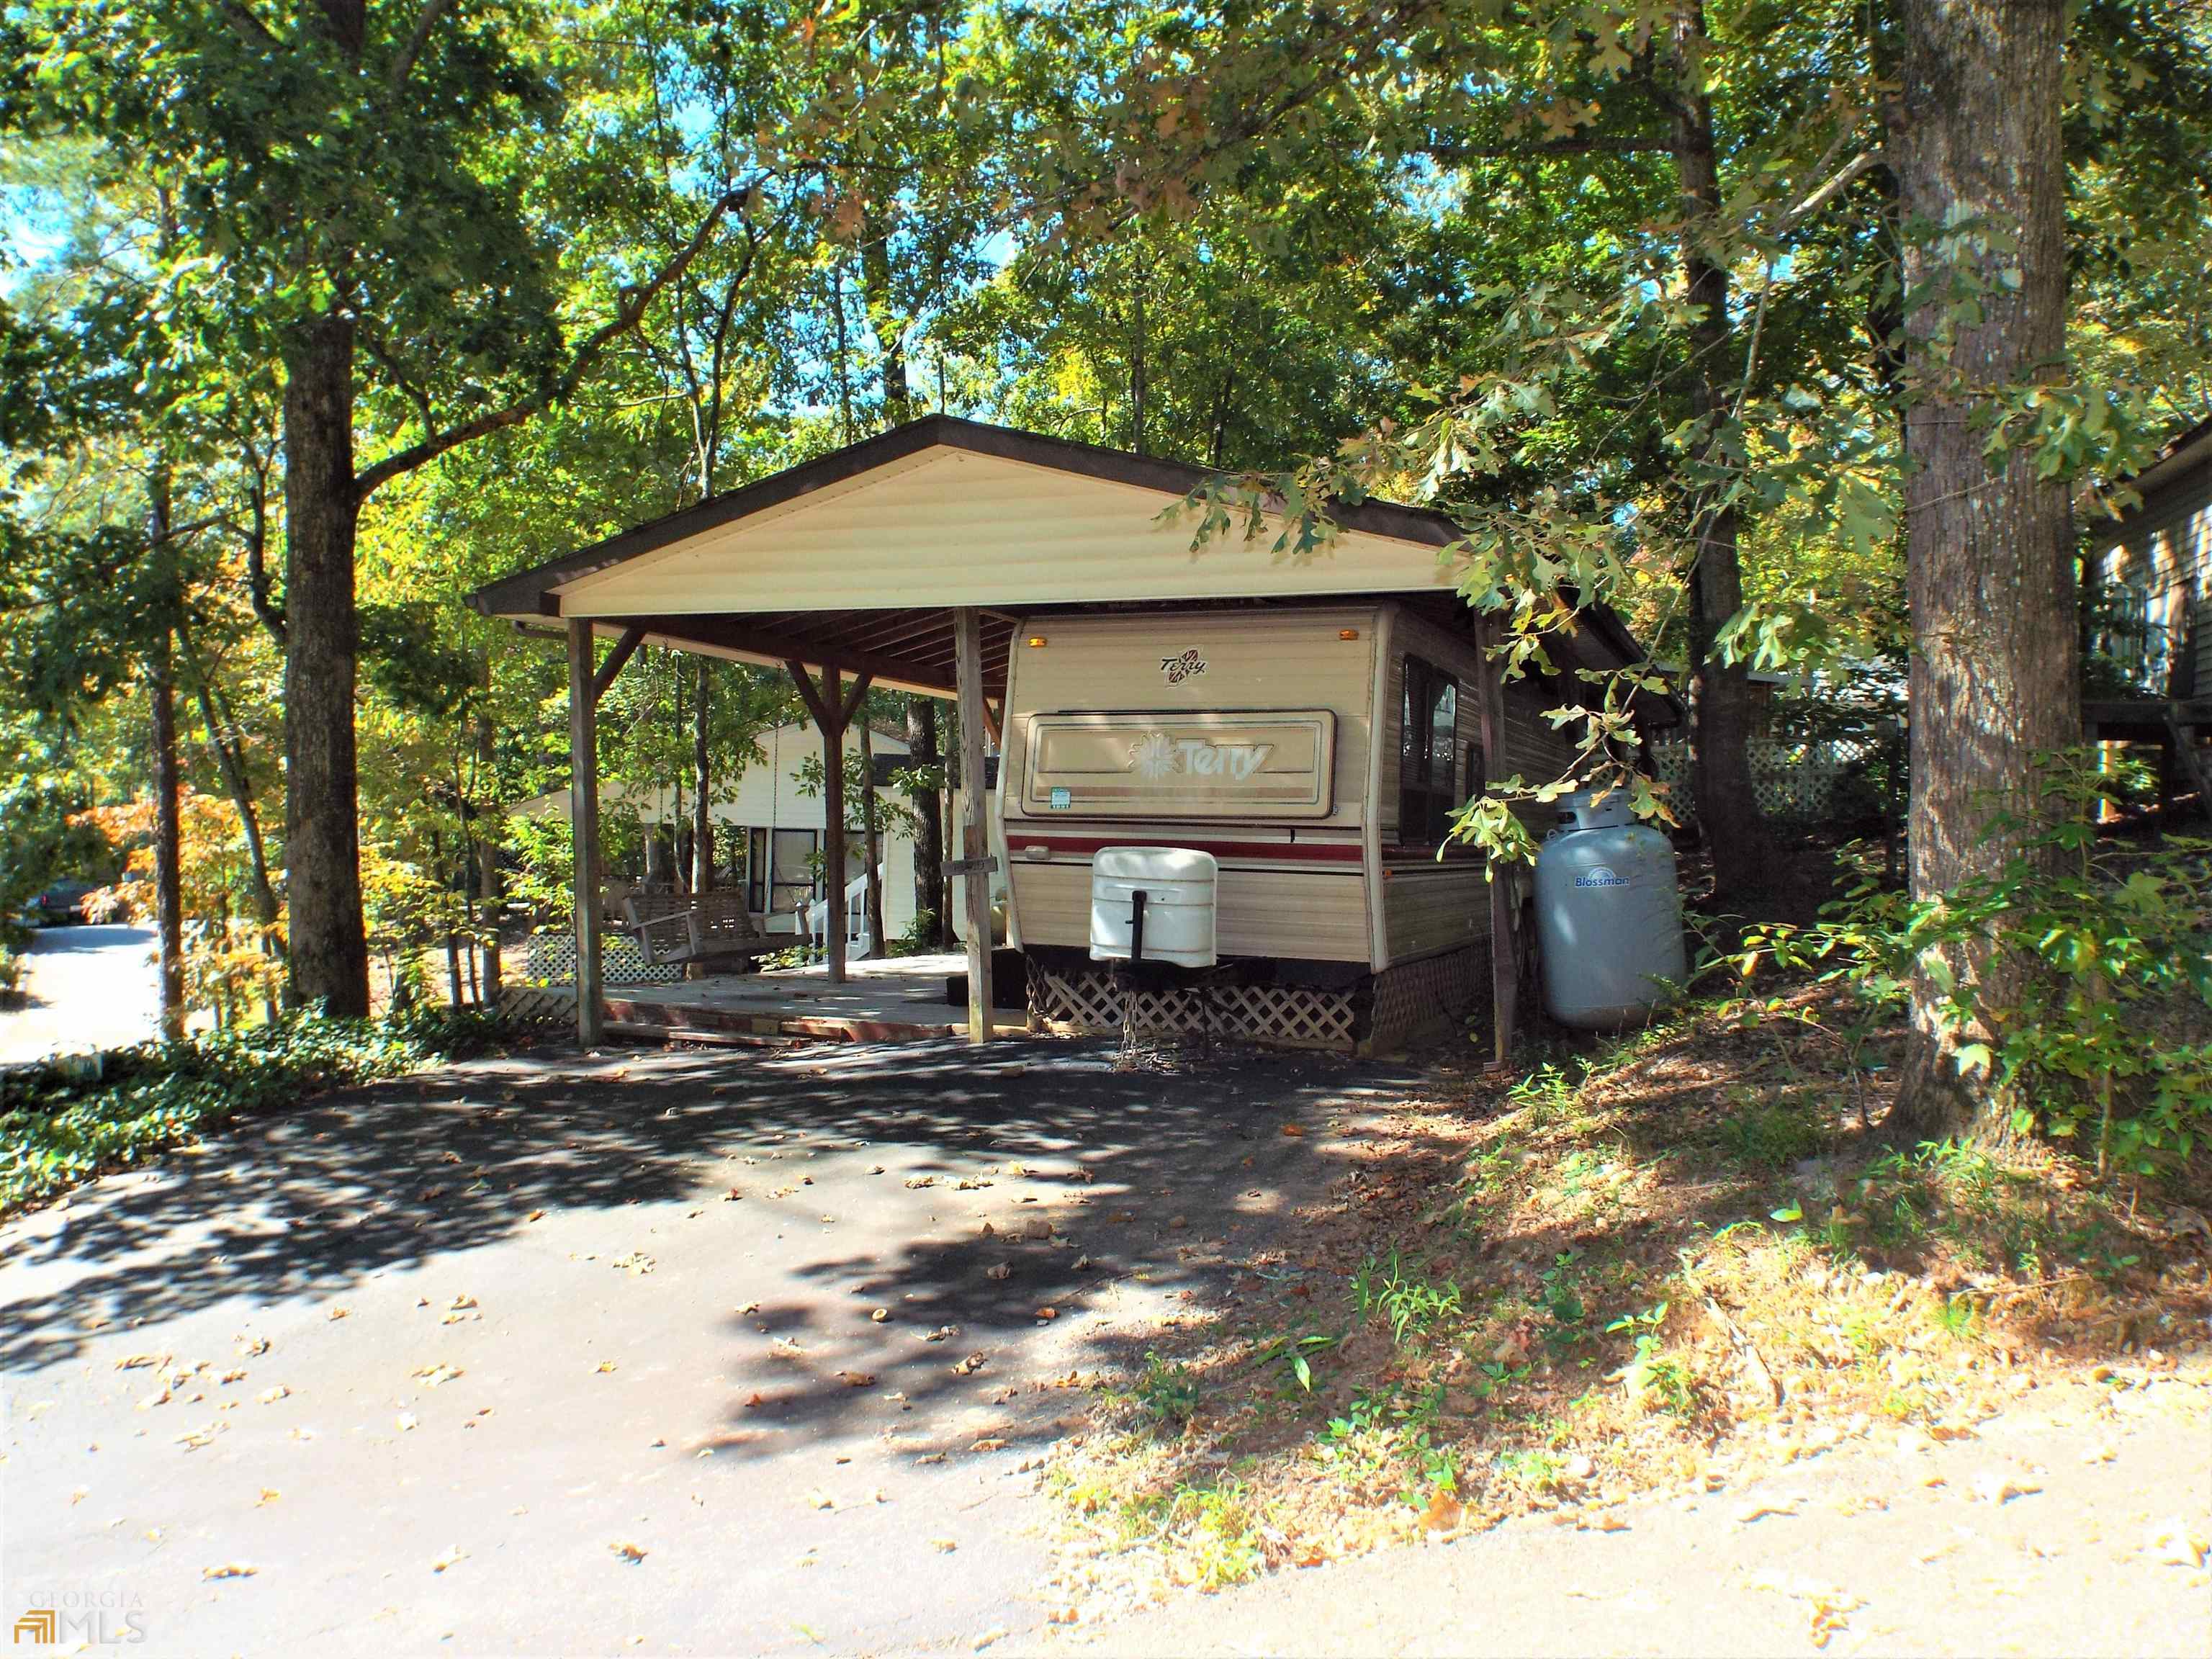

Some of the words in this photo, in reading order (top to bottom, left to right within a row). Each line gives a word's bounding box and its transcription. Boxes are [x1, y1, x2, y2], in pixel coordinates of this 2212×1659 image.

[1161, 657, 1206, 675] Terry
[1177, 739, 1272, 781] Terry
[1575, 876, 1629, 887] Blossman
